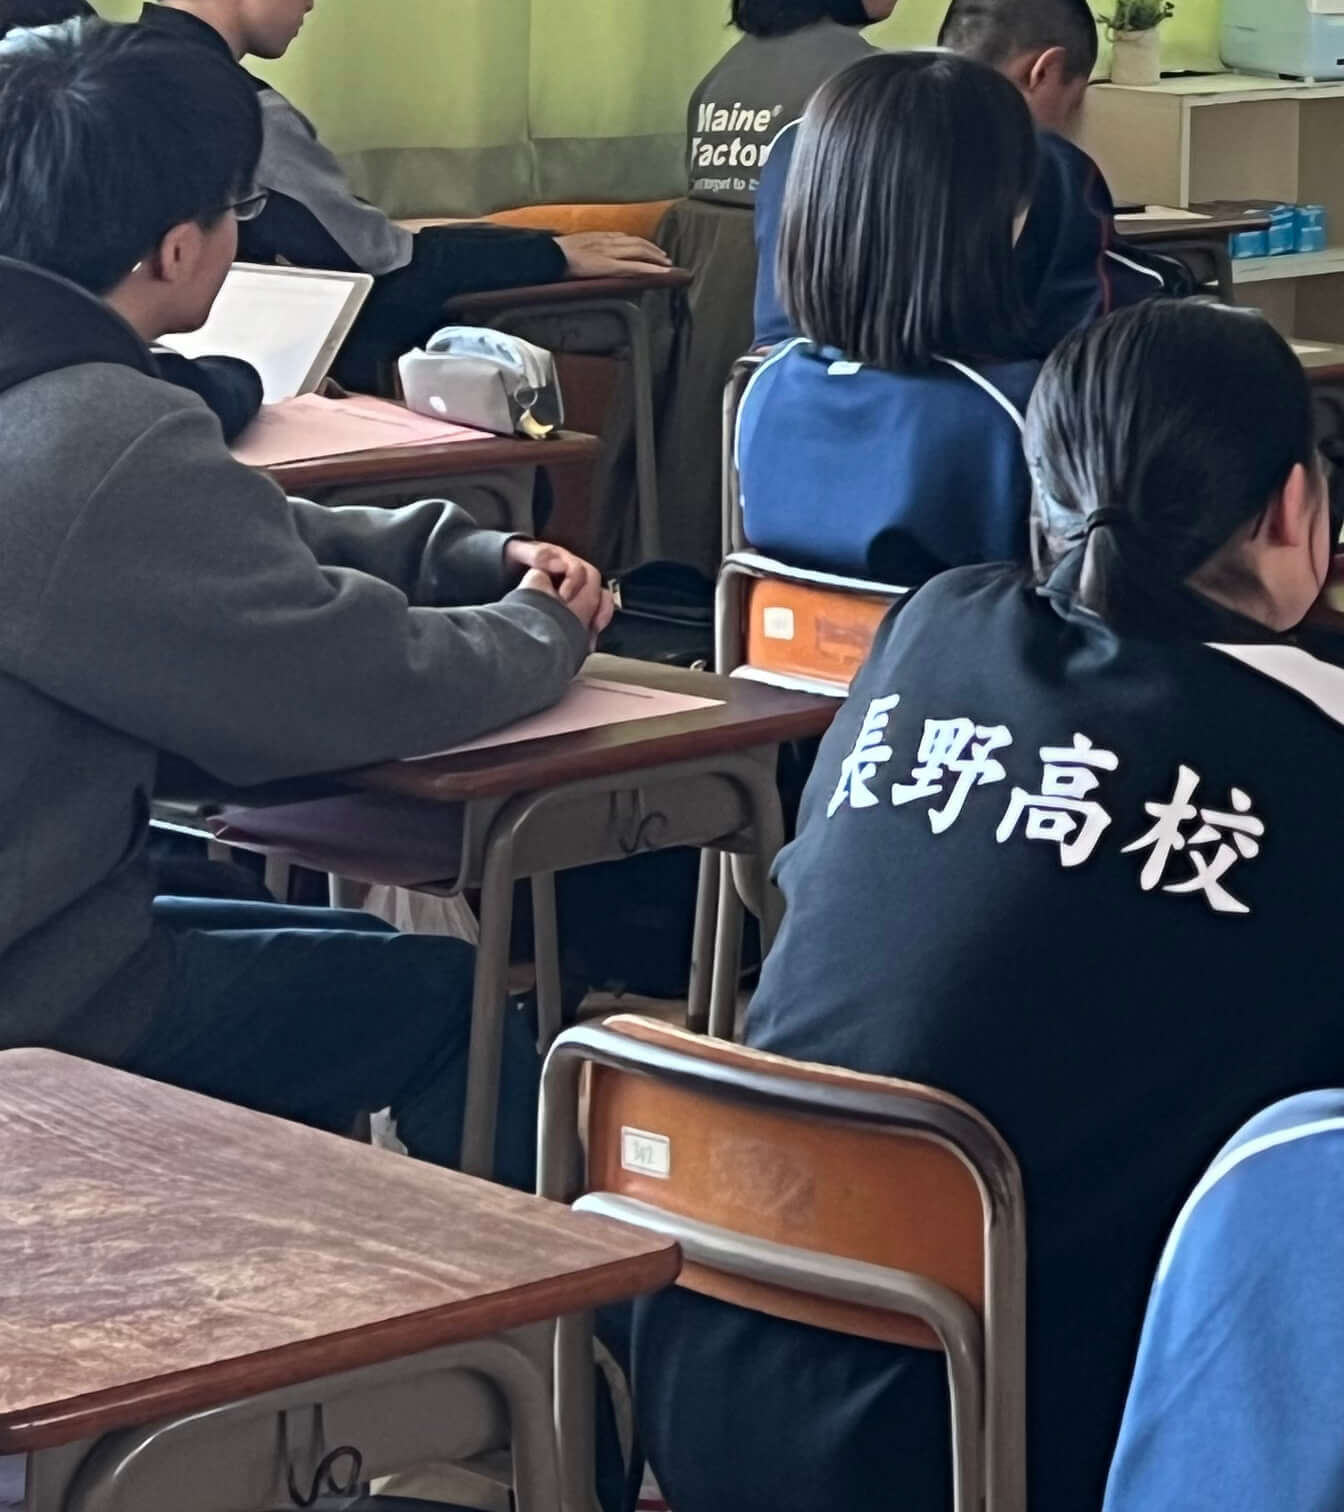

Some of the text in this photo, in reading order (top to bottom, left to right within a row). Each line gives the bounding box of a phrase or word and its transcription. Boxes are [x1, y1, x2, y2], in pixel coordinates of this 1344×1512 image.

[696, 101, 771, 133] Maine
[826, 694, 1265, 913] 長野高校
